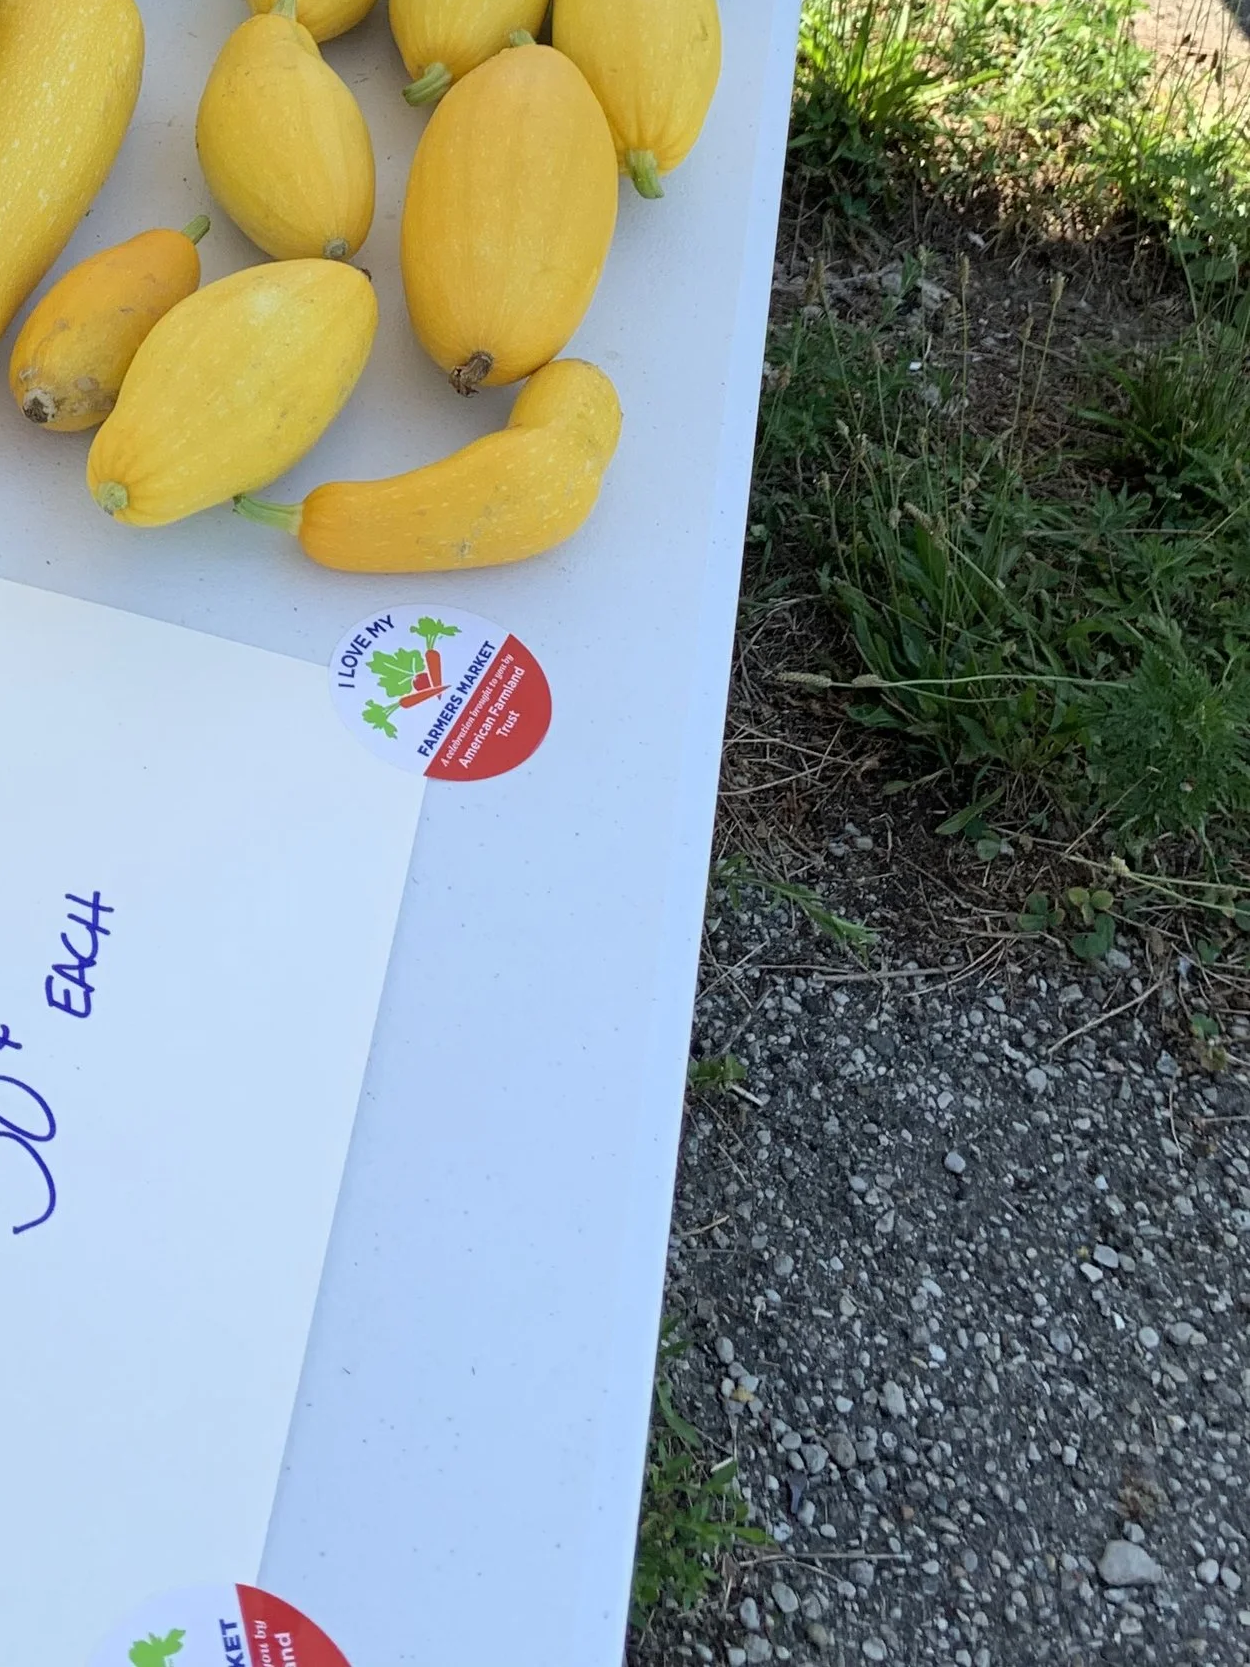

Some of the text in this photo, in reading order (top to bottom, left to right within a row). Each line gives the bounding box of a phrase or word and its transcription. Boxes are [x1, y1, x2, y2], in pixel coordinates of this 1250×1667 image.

[338, 634, 372, 678] LOVE
[365, 614, 395, 639] MY
[416, 640, 496, 758] FARMERS MARKET
[444, 715, 474, 762] celebration
[471, 686, 493, 718] brought
[494, 663, 509, 681] you
[504, 653, 514, 666] by
[457, 666, 526, 769] American Farmland
[495, 709, 520, 739] Trust
[44, 890, 115, 1018] EACH
[218, 1618, 247, 1667] KET
[253, 1619, 268, 1640] by
